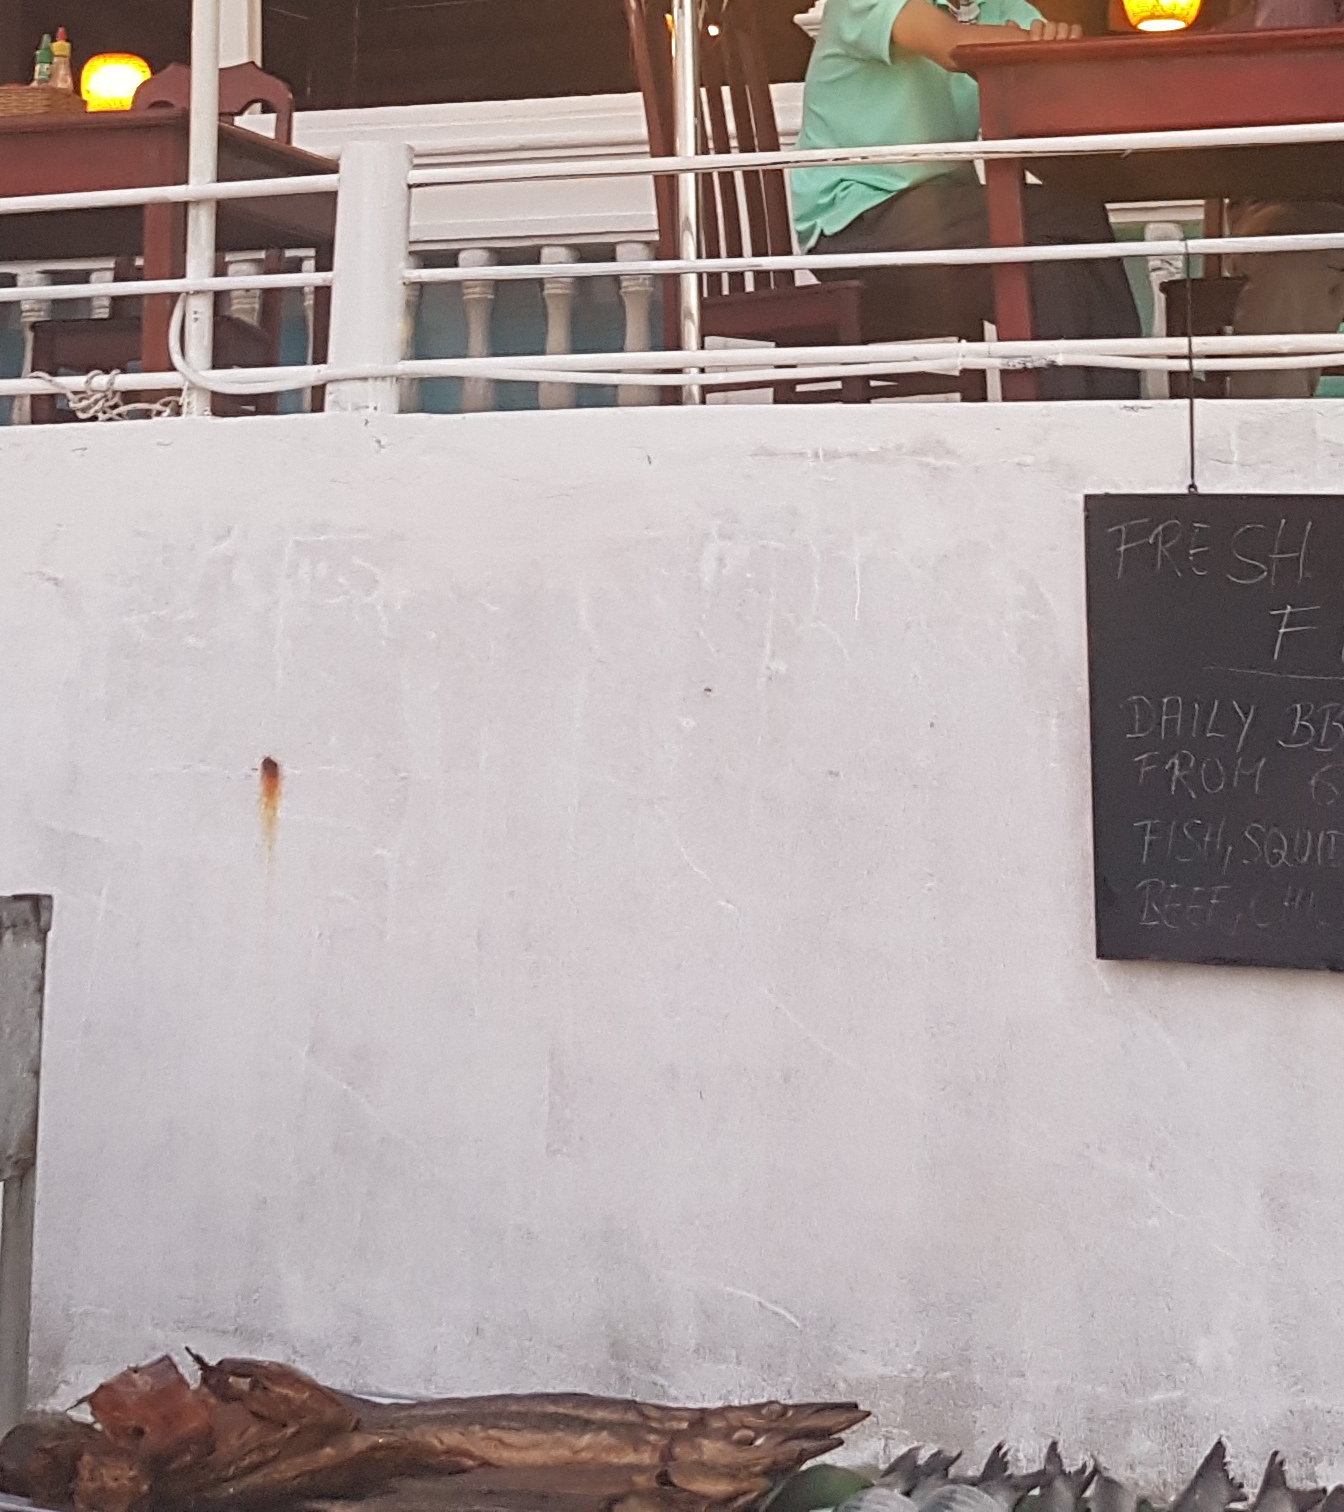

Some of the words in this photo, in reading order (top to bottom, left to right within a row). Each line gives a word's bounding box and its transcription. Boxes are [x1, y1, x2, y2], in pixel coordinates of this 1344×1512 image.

[1106, 517, 1312, 588] FRESH
[1120, 693, 1256, 754] DAILY
[1131, 749, 1267, 801] FROM
